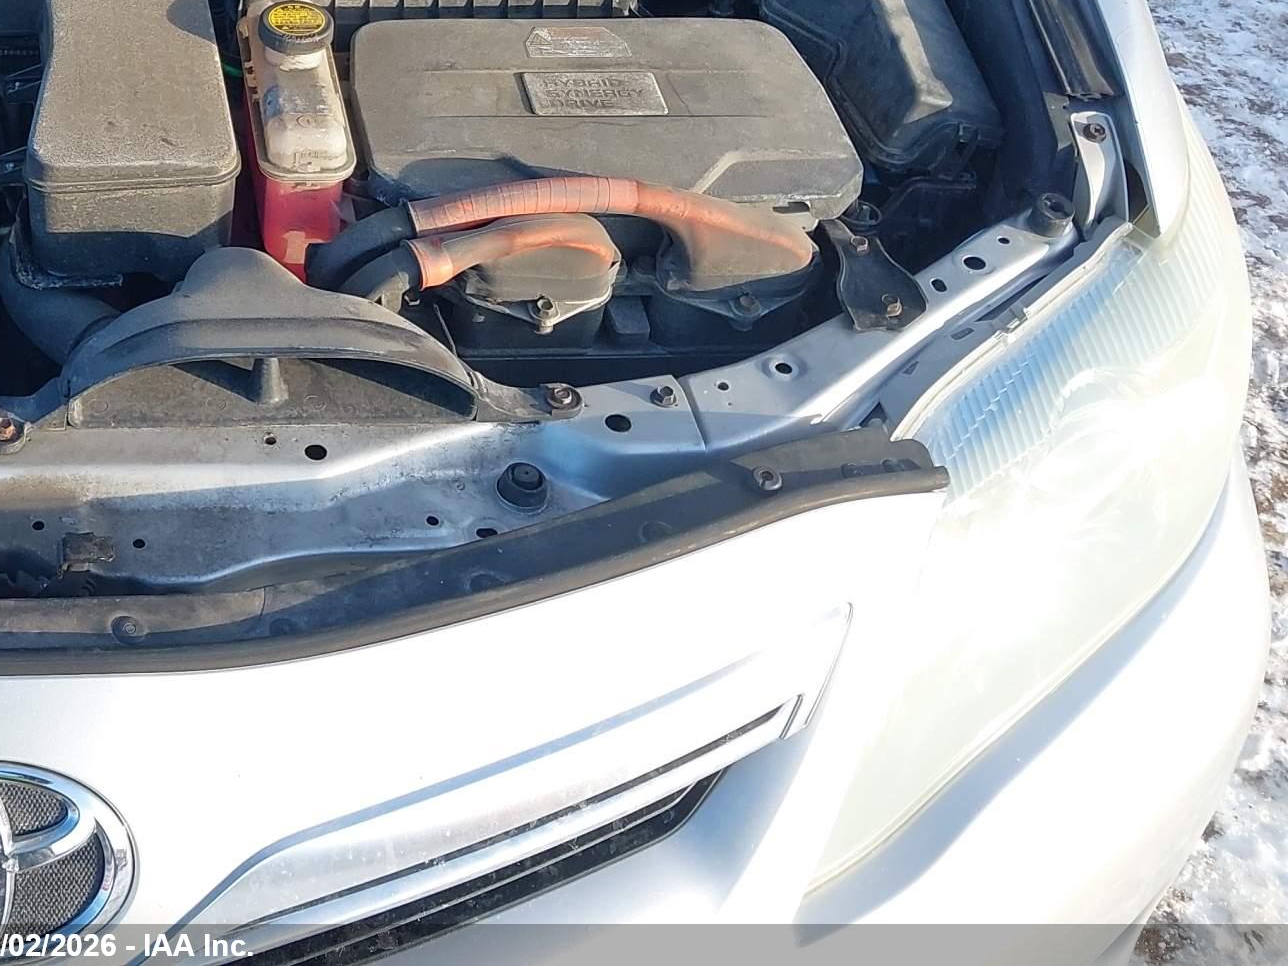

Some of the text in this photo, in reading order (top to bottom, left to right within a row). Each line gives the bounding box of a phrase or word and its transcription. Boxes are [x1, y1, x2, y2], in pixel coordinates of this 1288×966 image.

[543, 77, 623, 88] HYBRID
[546, 89, 643, 98] SYNERGY
[548, 99, 615, 108] DRIVE
